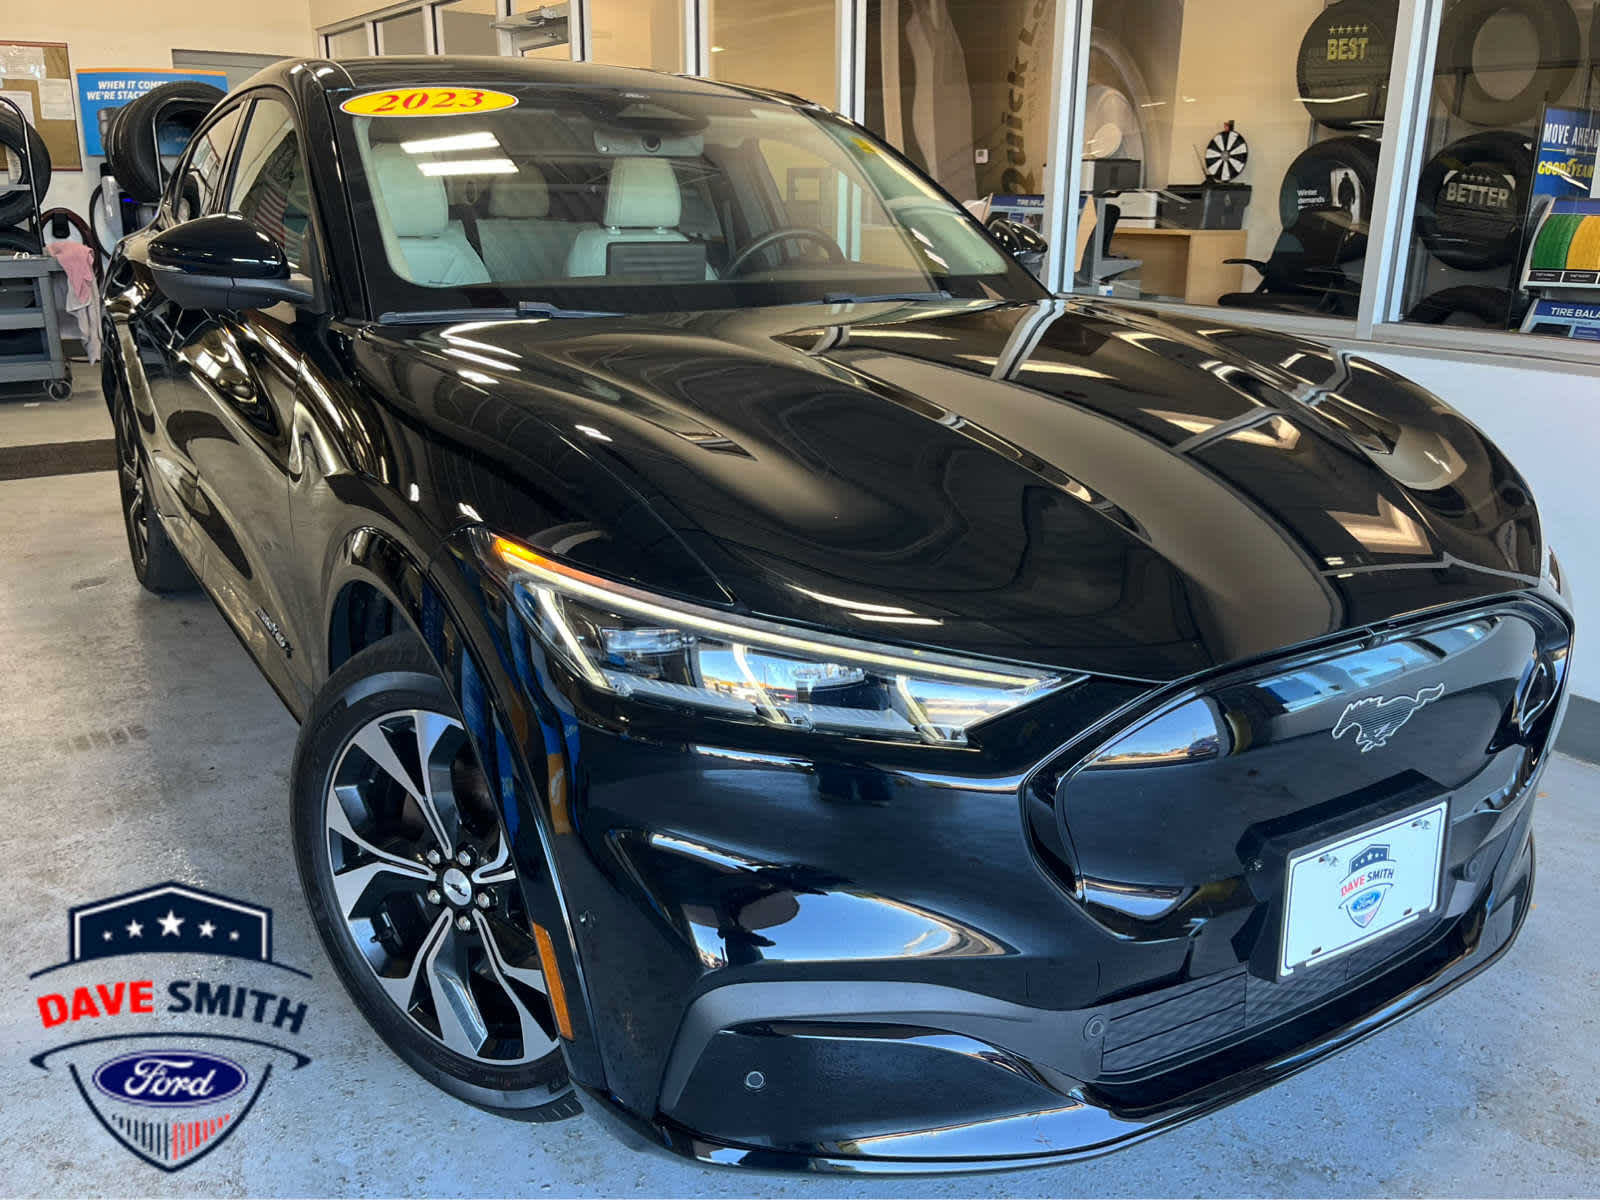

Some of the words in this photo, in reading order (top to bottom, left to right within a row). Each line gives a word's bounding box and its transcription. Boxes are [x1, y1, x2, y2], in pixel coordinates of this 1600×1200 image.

[1328, 38, 1368, 60] BEST
[98, 80, 126, 89] WHEN
[127, 80, 137, 89] IT
[87, 91, 116, 100] WE'RE
[372, 91, 485, 113] 2023
[1543, 123, 1570, 144] MOVE
[1446, 182, 1509, 208] BETTER
[1550, 307, 1574, 317] TIRE
[1341, 874, 1365, 897] DAVE
[1367, 868, 1394, 882] SMITH
